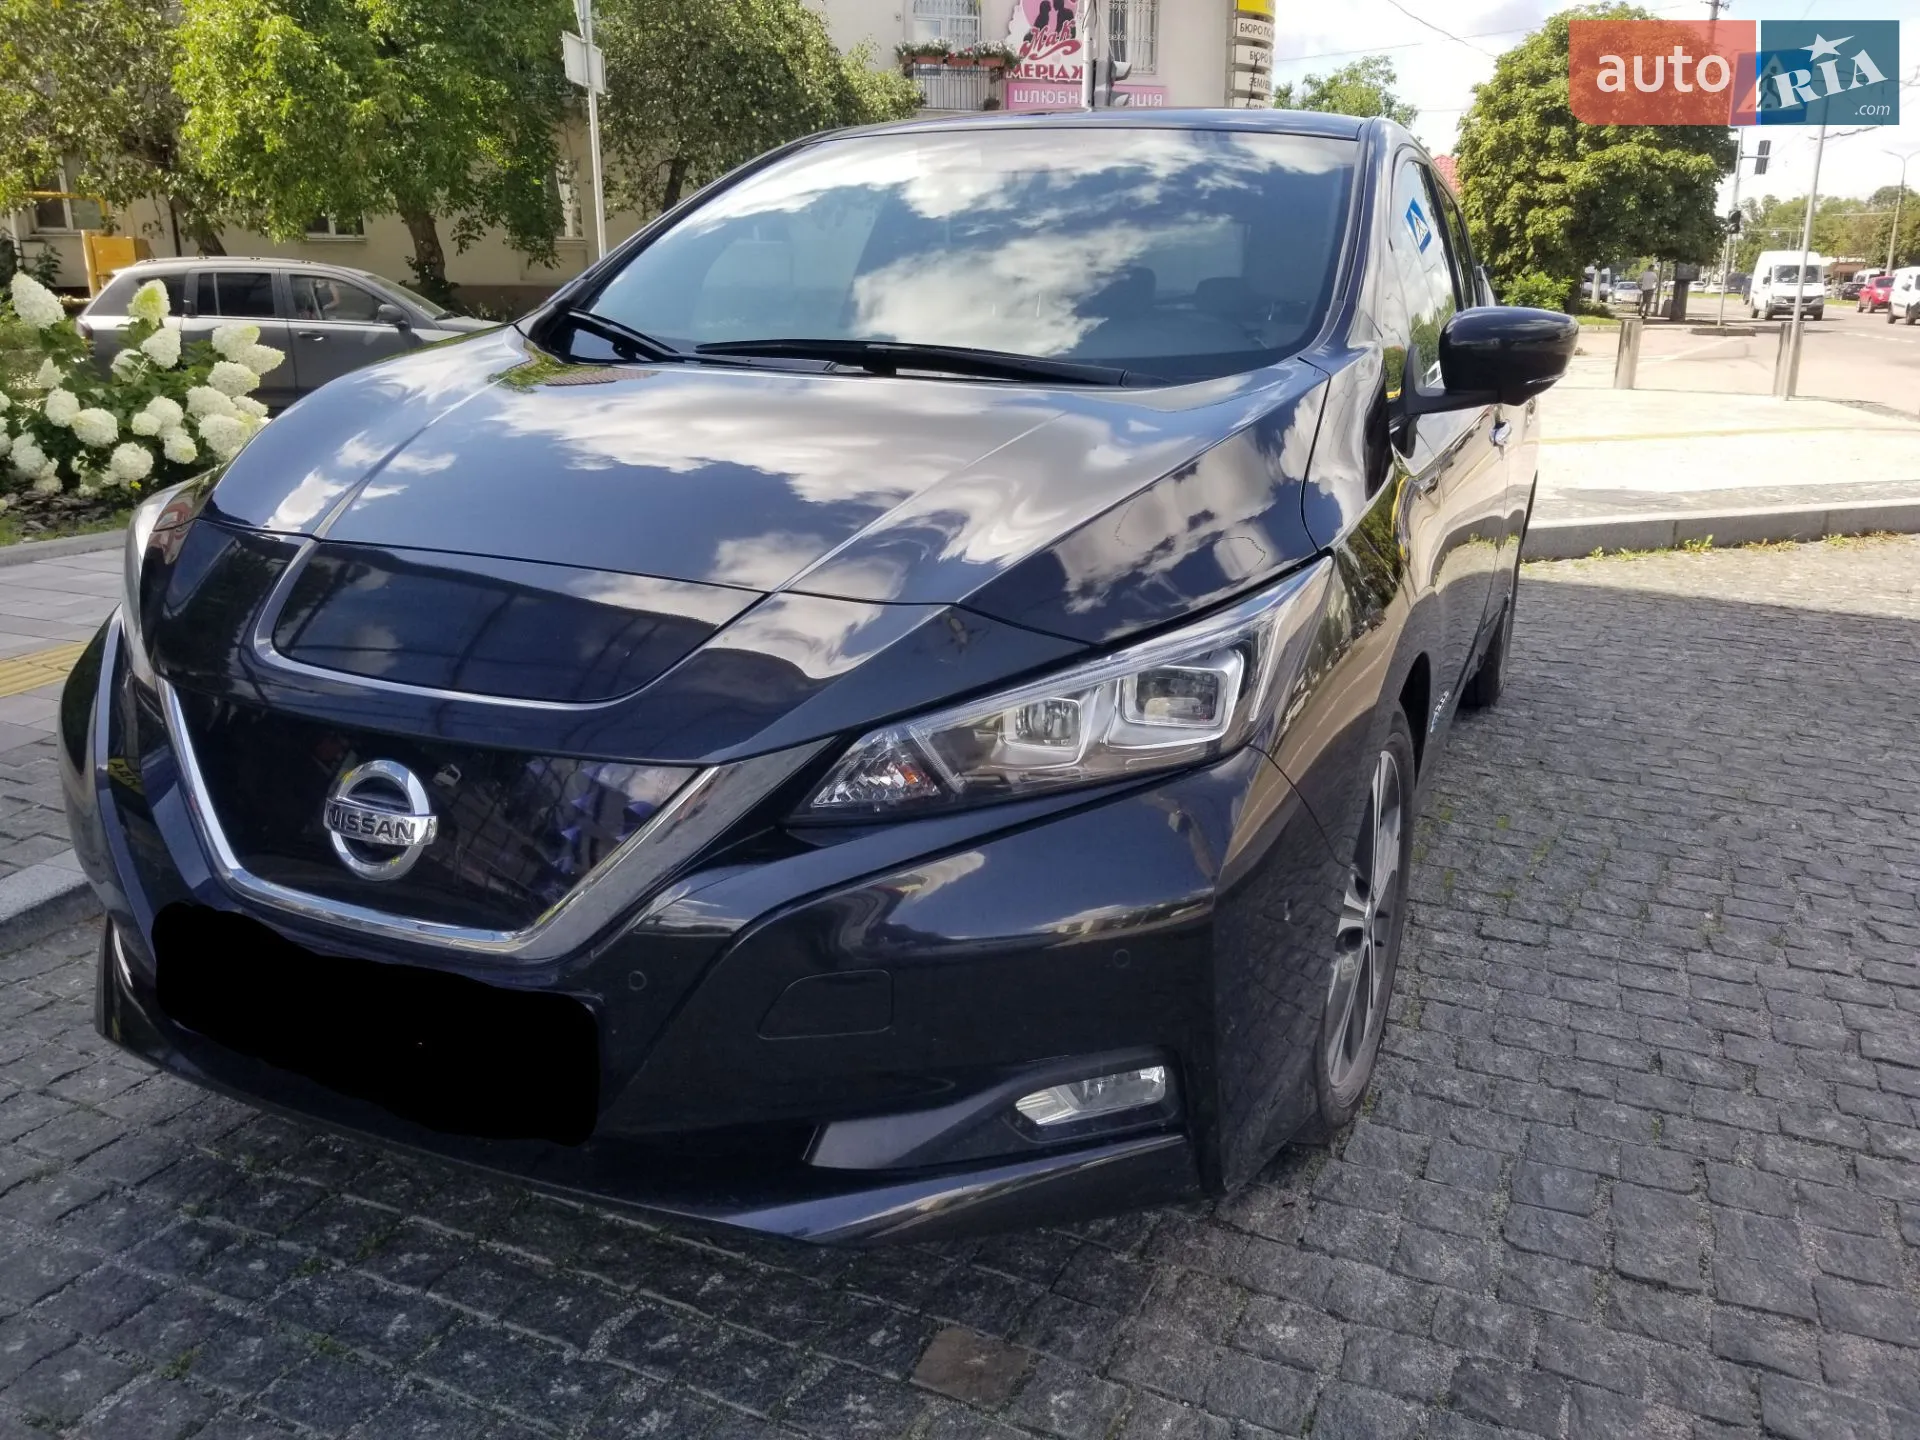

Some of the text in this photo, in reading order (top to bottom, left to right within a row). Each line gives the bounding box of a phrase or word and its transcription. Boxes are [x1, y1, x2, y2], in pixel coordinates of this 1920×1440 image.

[1240, 22, 1263, 35] БЮРО
[1013, 90, 1082, 104] ШЛЮБН
[328, 807, 416, 840] NISSAN
